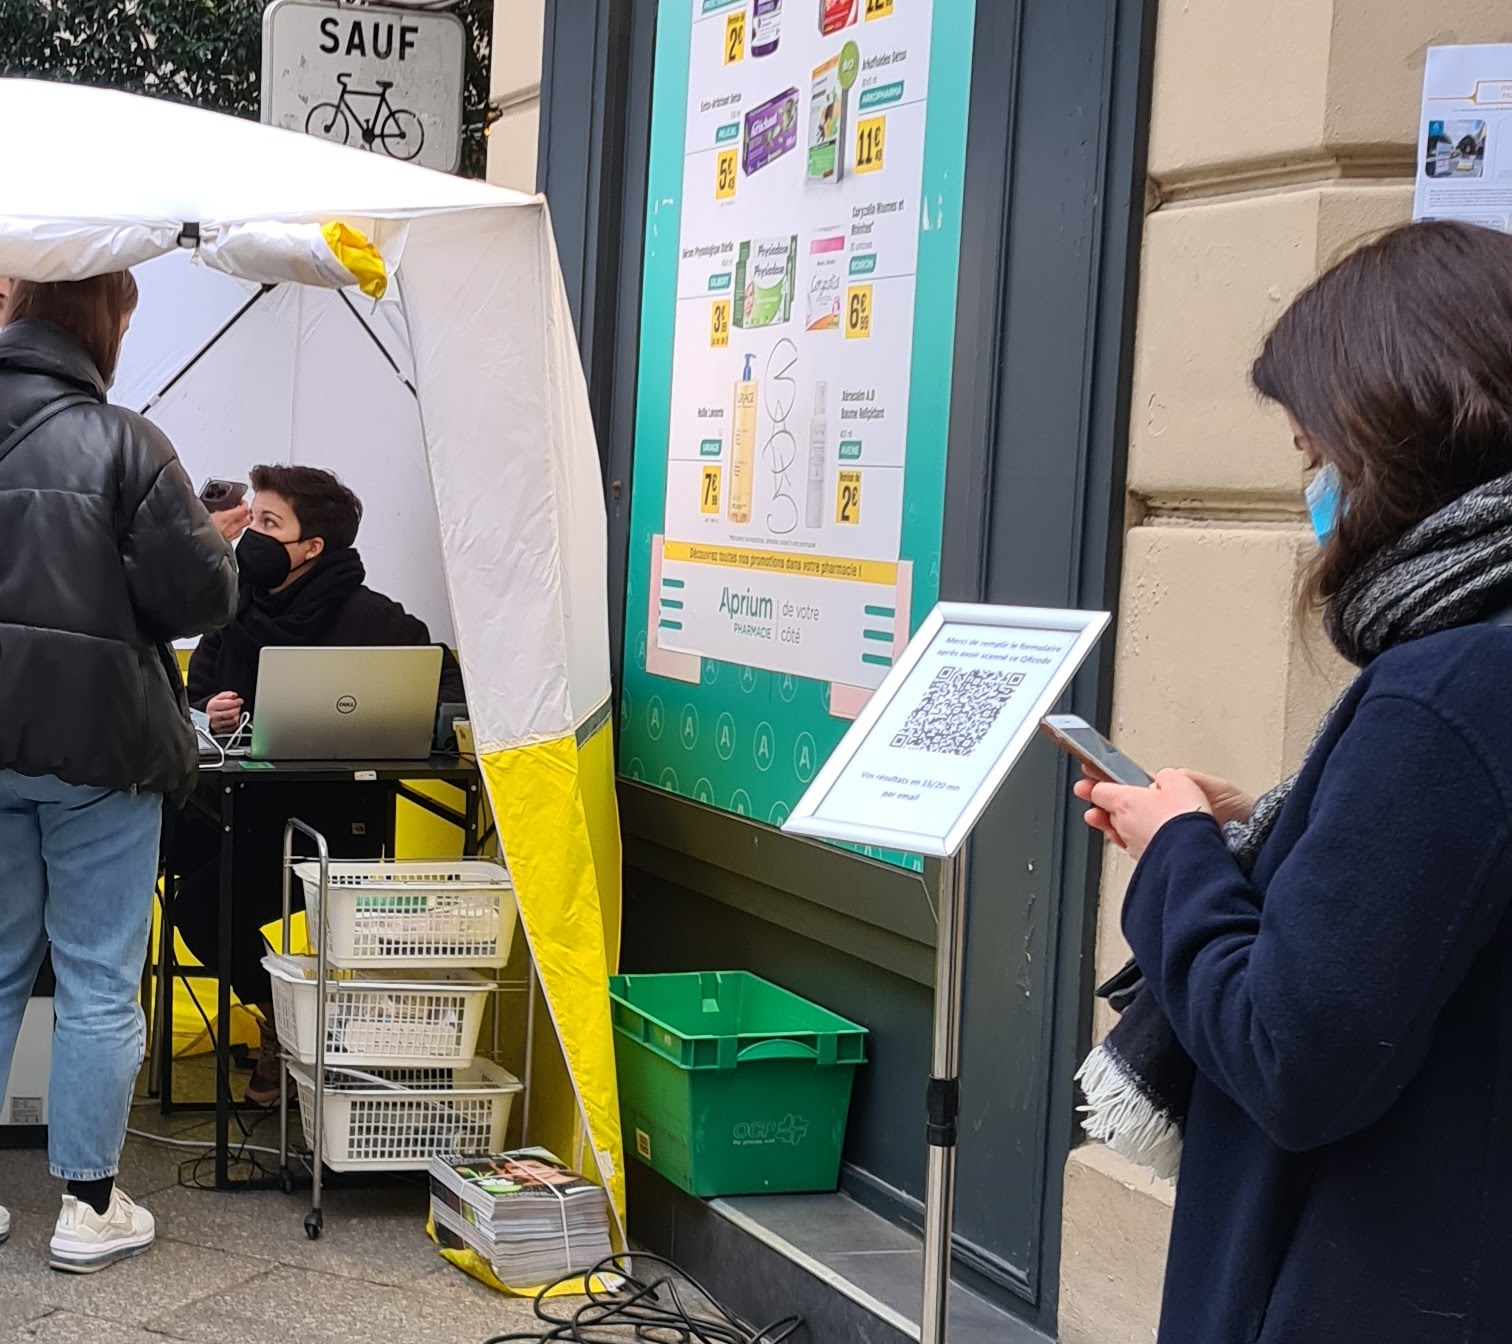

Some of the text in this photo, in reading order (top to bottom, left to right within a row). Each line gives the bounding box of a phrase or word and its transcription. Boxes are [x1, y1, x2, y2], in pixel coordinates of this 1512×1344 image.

[319, 17, 419, 61] SAUF
[689, 547, 718, 562] Découvrez
[719, 552, 737, 563] toutes
[738, 555, 749, 565] nos
[750, 555, 785, 570] promotions
[786, 558, 801, 572] dans
[803, 561, 820, 573] votre
[821, 562, 857, 577] pharmacie
[719, 586, 820, 622] Aprium de votre
[734, 622, 801, 644] PHARMACIE côté
